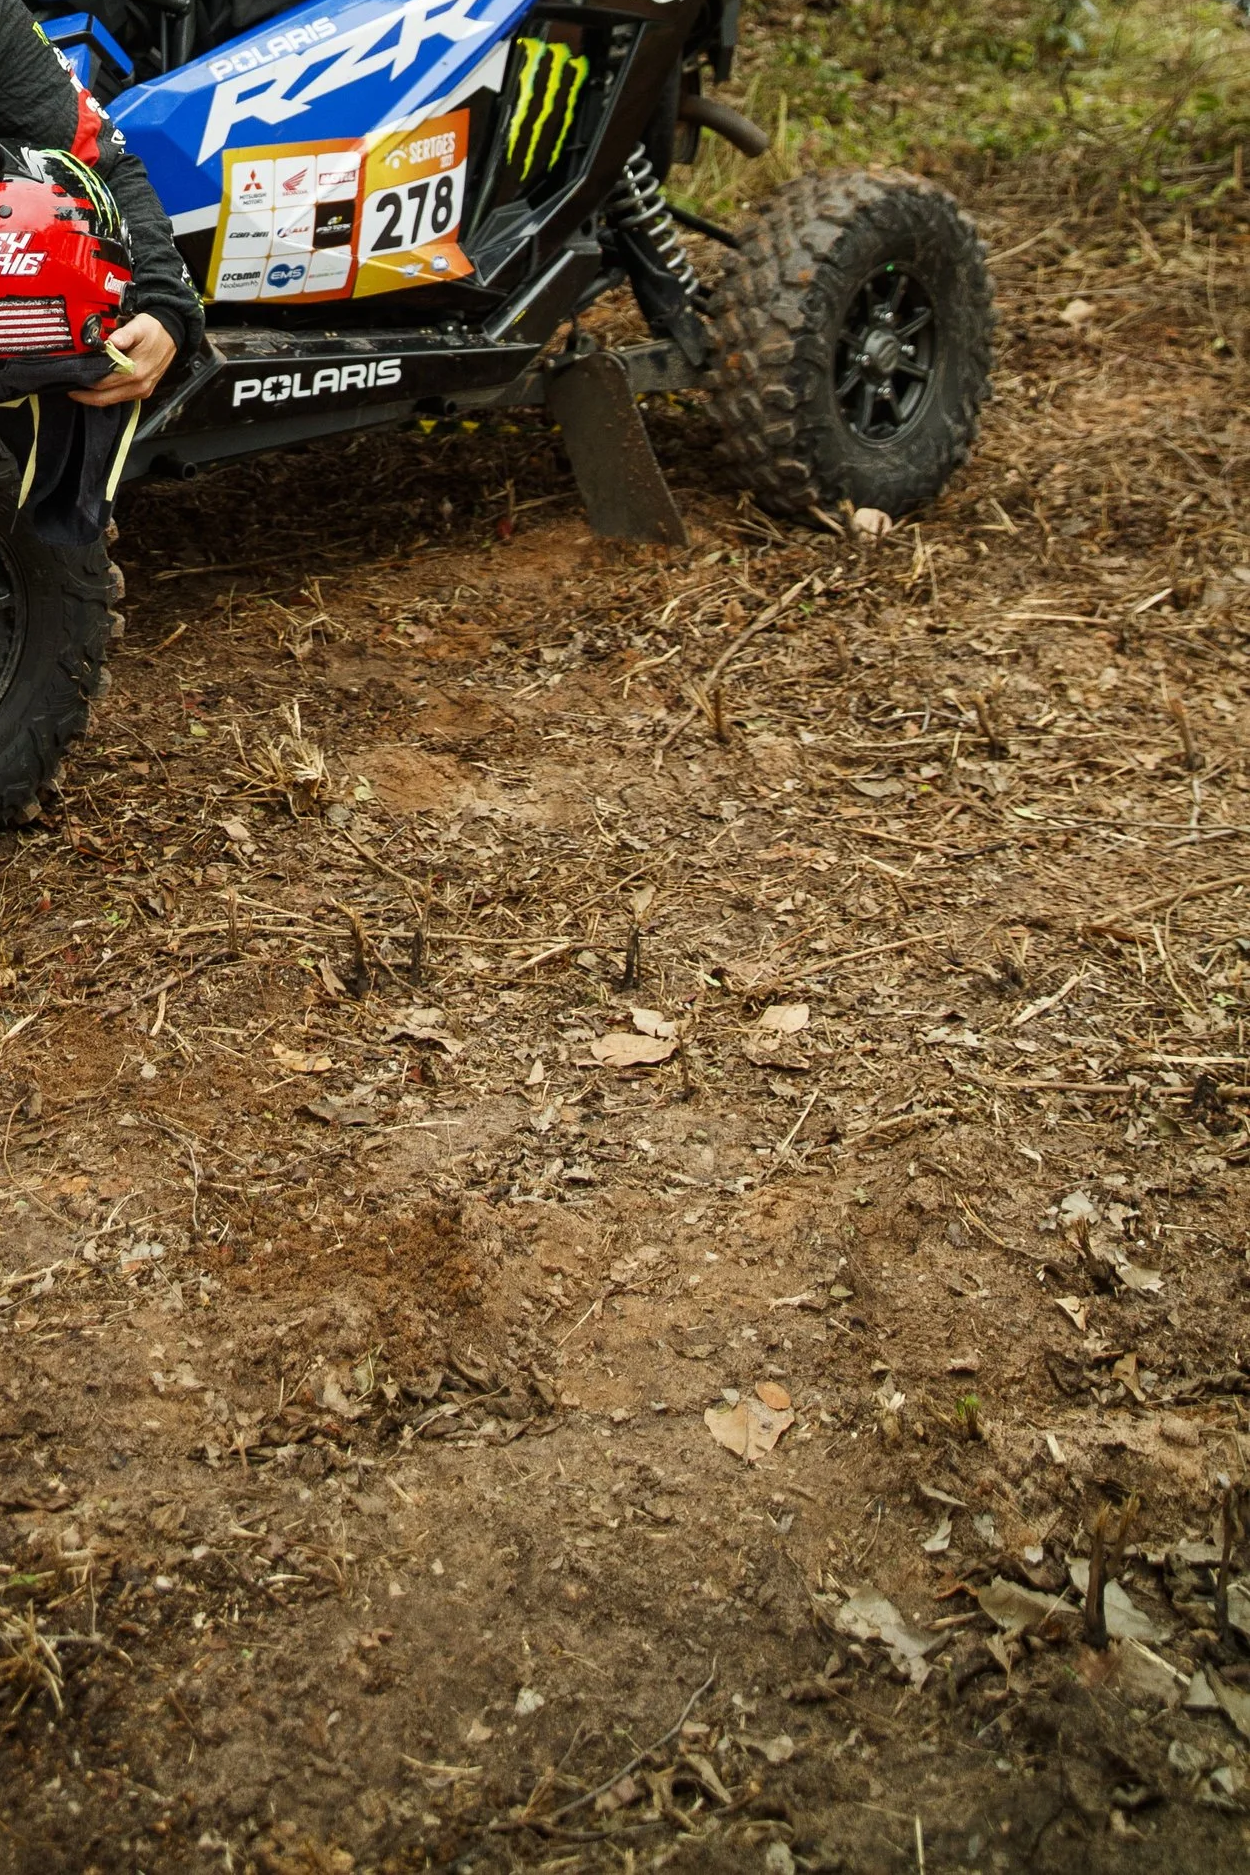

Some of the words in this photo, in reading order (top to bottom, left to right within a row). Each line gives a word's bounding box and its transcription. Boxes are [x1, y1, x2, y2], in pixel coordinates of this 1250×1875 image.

[208, 16, 337, 82] POLARIS
[370, 175, 454, 252] 278
[268, 268, 303, 281] EMS
[232, 358, 402, 407] POLARIS
